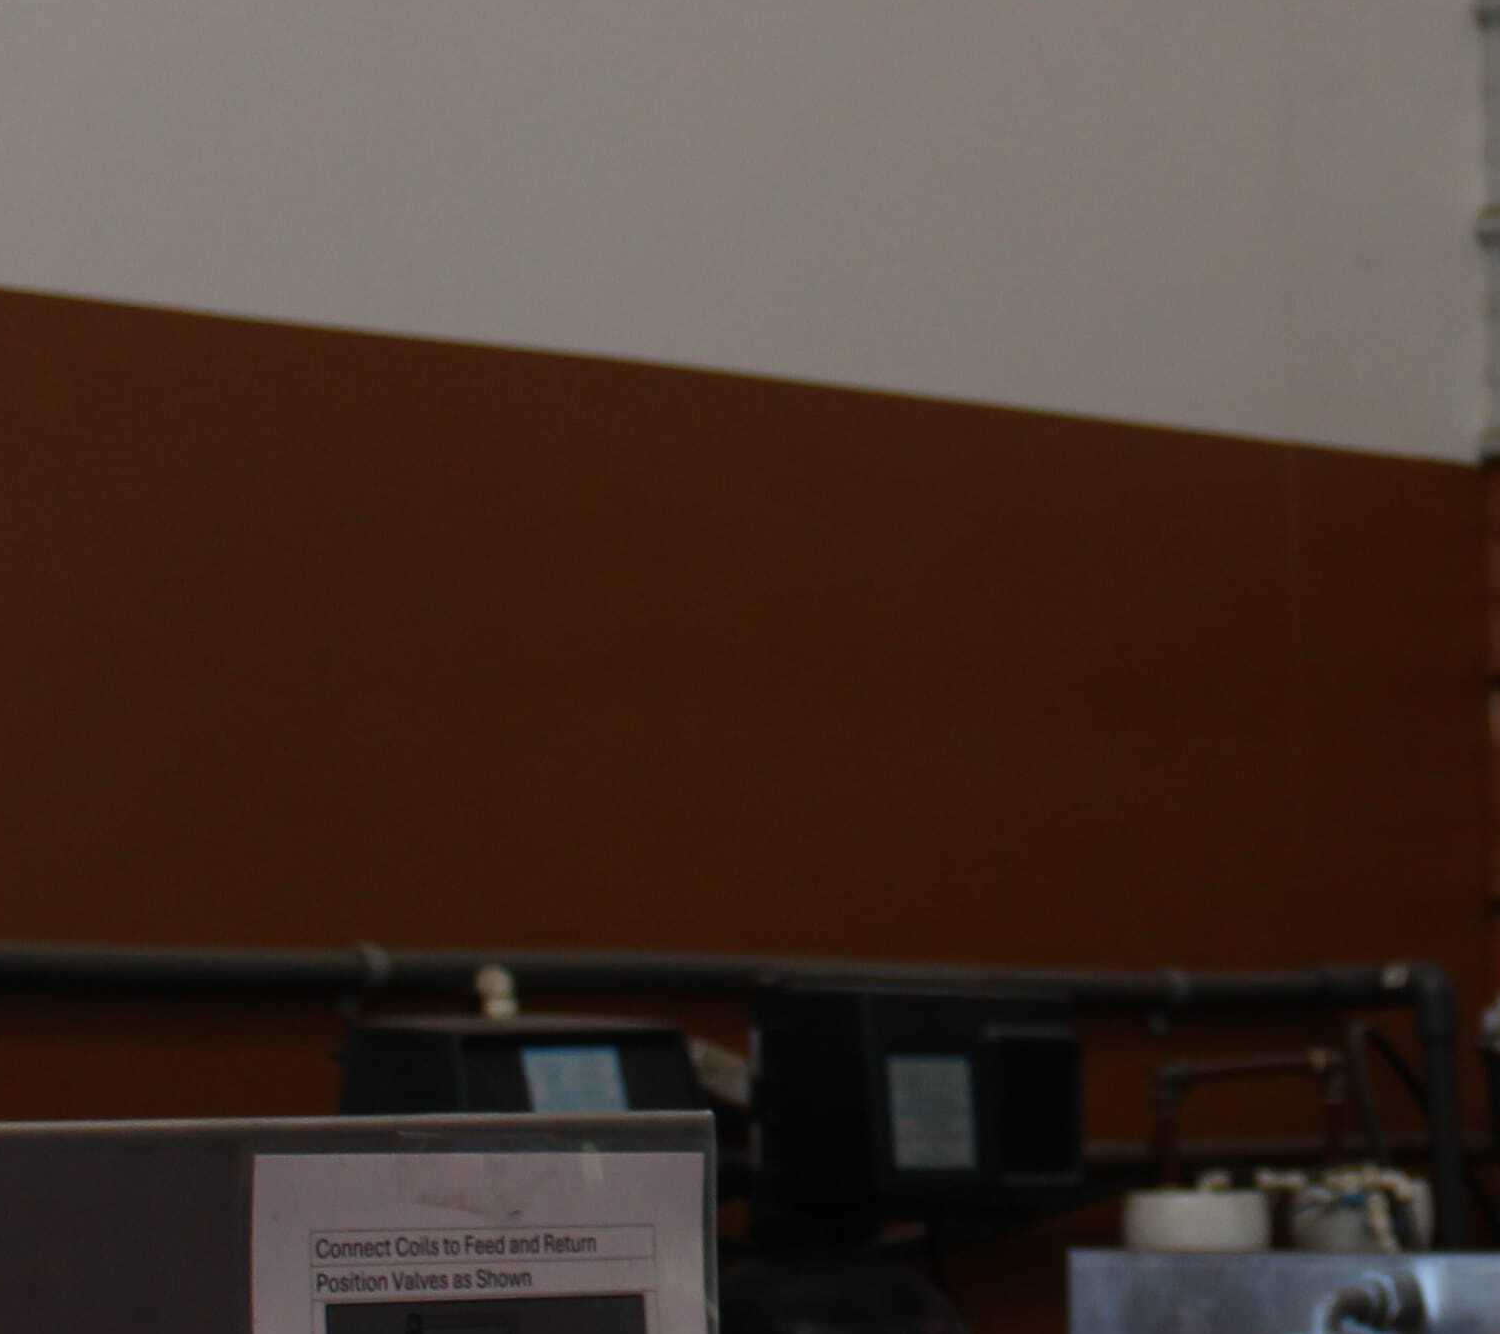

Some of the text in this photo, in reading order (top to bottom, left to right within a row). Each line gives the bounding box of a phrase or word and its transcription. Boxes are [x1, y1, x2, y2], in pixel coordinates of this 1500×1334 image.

[315, 1232, 597, 1260] Connect Coils to Feed and Return
[316, 1268, 532, 1295] Position Valves as Shown
